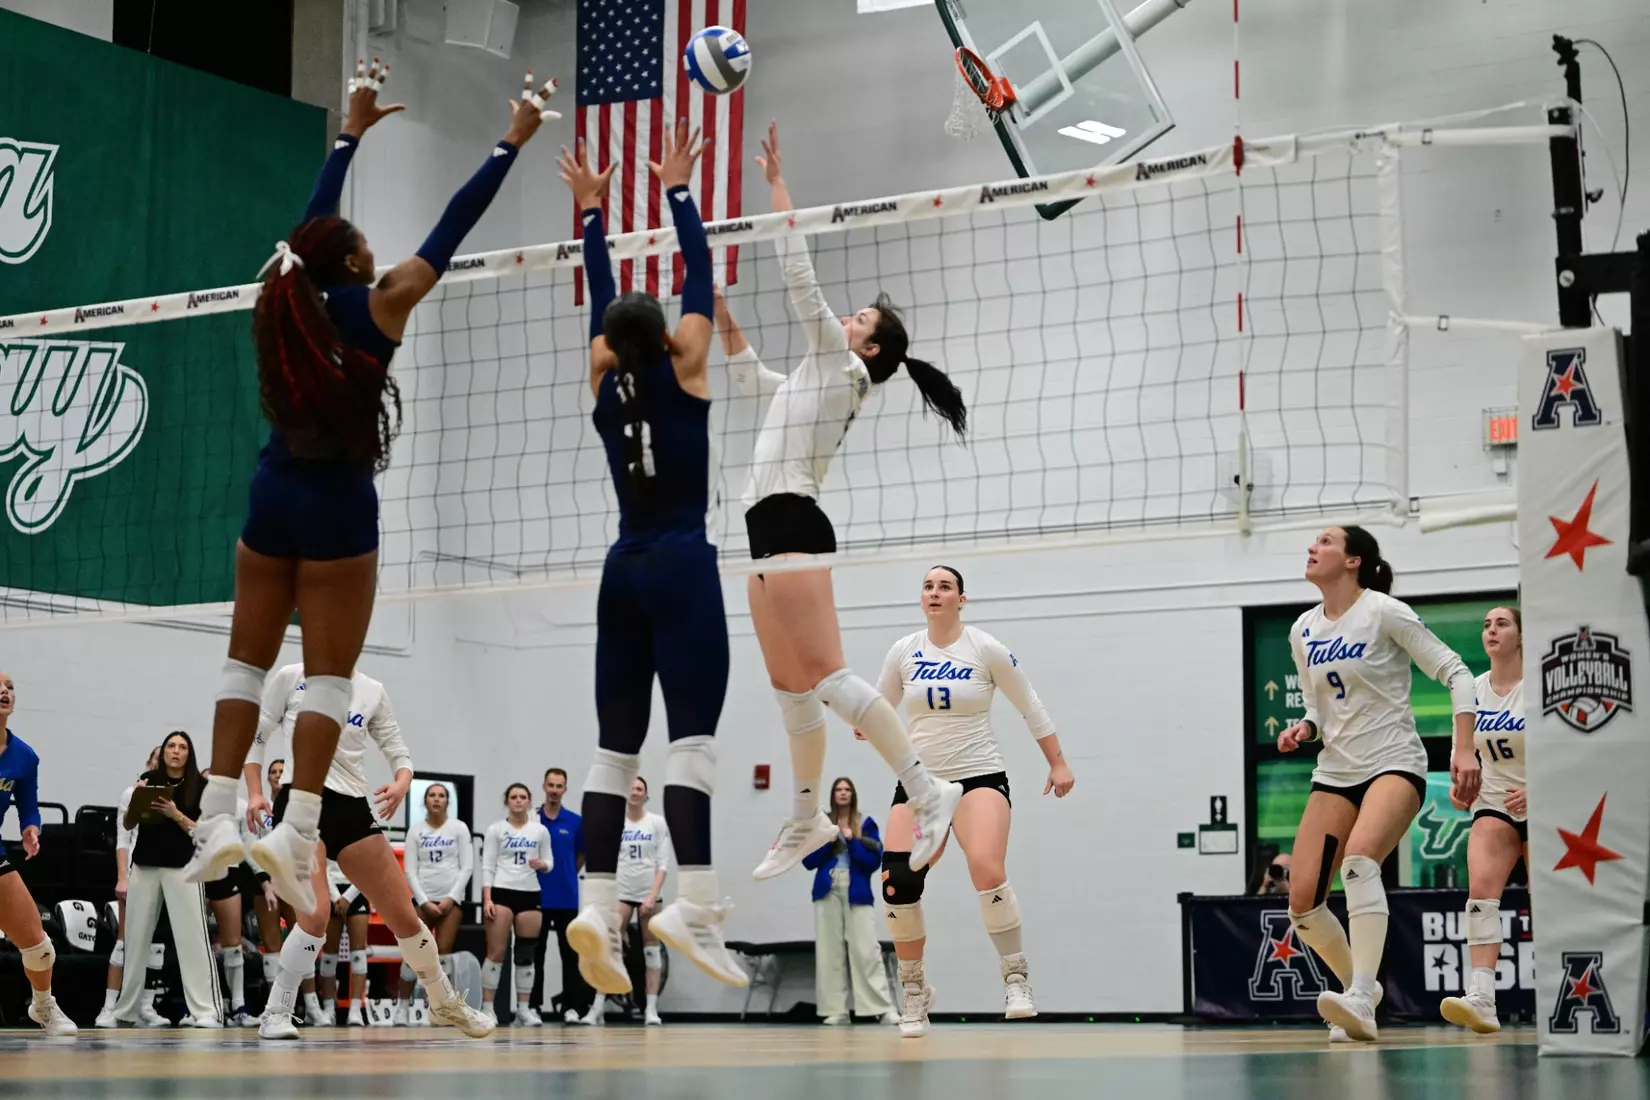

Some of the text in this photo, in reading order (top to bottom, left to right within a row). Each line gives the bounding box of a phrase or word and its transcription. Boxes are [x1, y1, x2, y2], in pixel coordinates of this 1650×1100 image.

[1135, 153, 1207, 181] AMERICAN
[979, 179, 1049, 204] AMERICAN
[831, 200, 897, 224] AMERICAN
[186, 289, 240, 309] AMERICAN
[74, 304, 125, 324] AMERICAN
[1305, 636, 1367, 667] Tulsa
[911, 660, 974, 682] Tulsa
[1545, 660, 1628, 695] VOLLEYBALL
[1326, 671, 1346, 700] 9
[926, 686, 951, 710] 13
[1485, 737, 1515, 762] 16
[418, 834, 456, 849] Tulsa
[502, 835, 538, 849] Tulsa
[629, 844, 642, 859] 21
[429, 850, 443, 863] 12
[514, 850, 527, 866] 15
